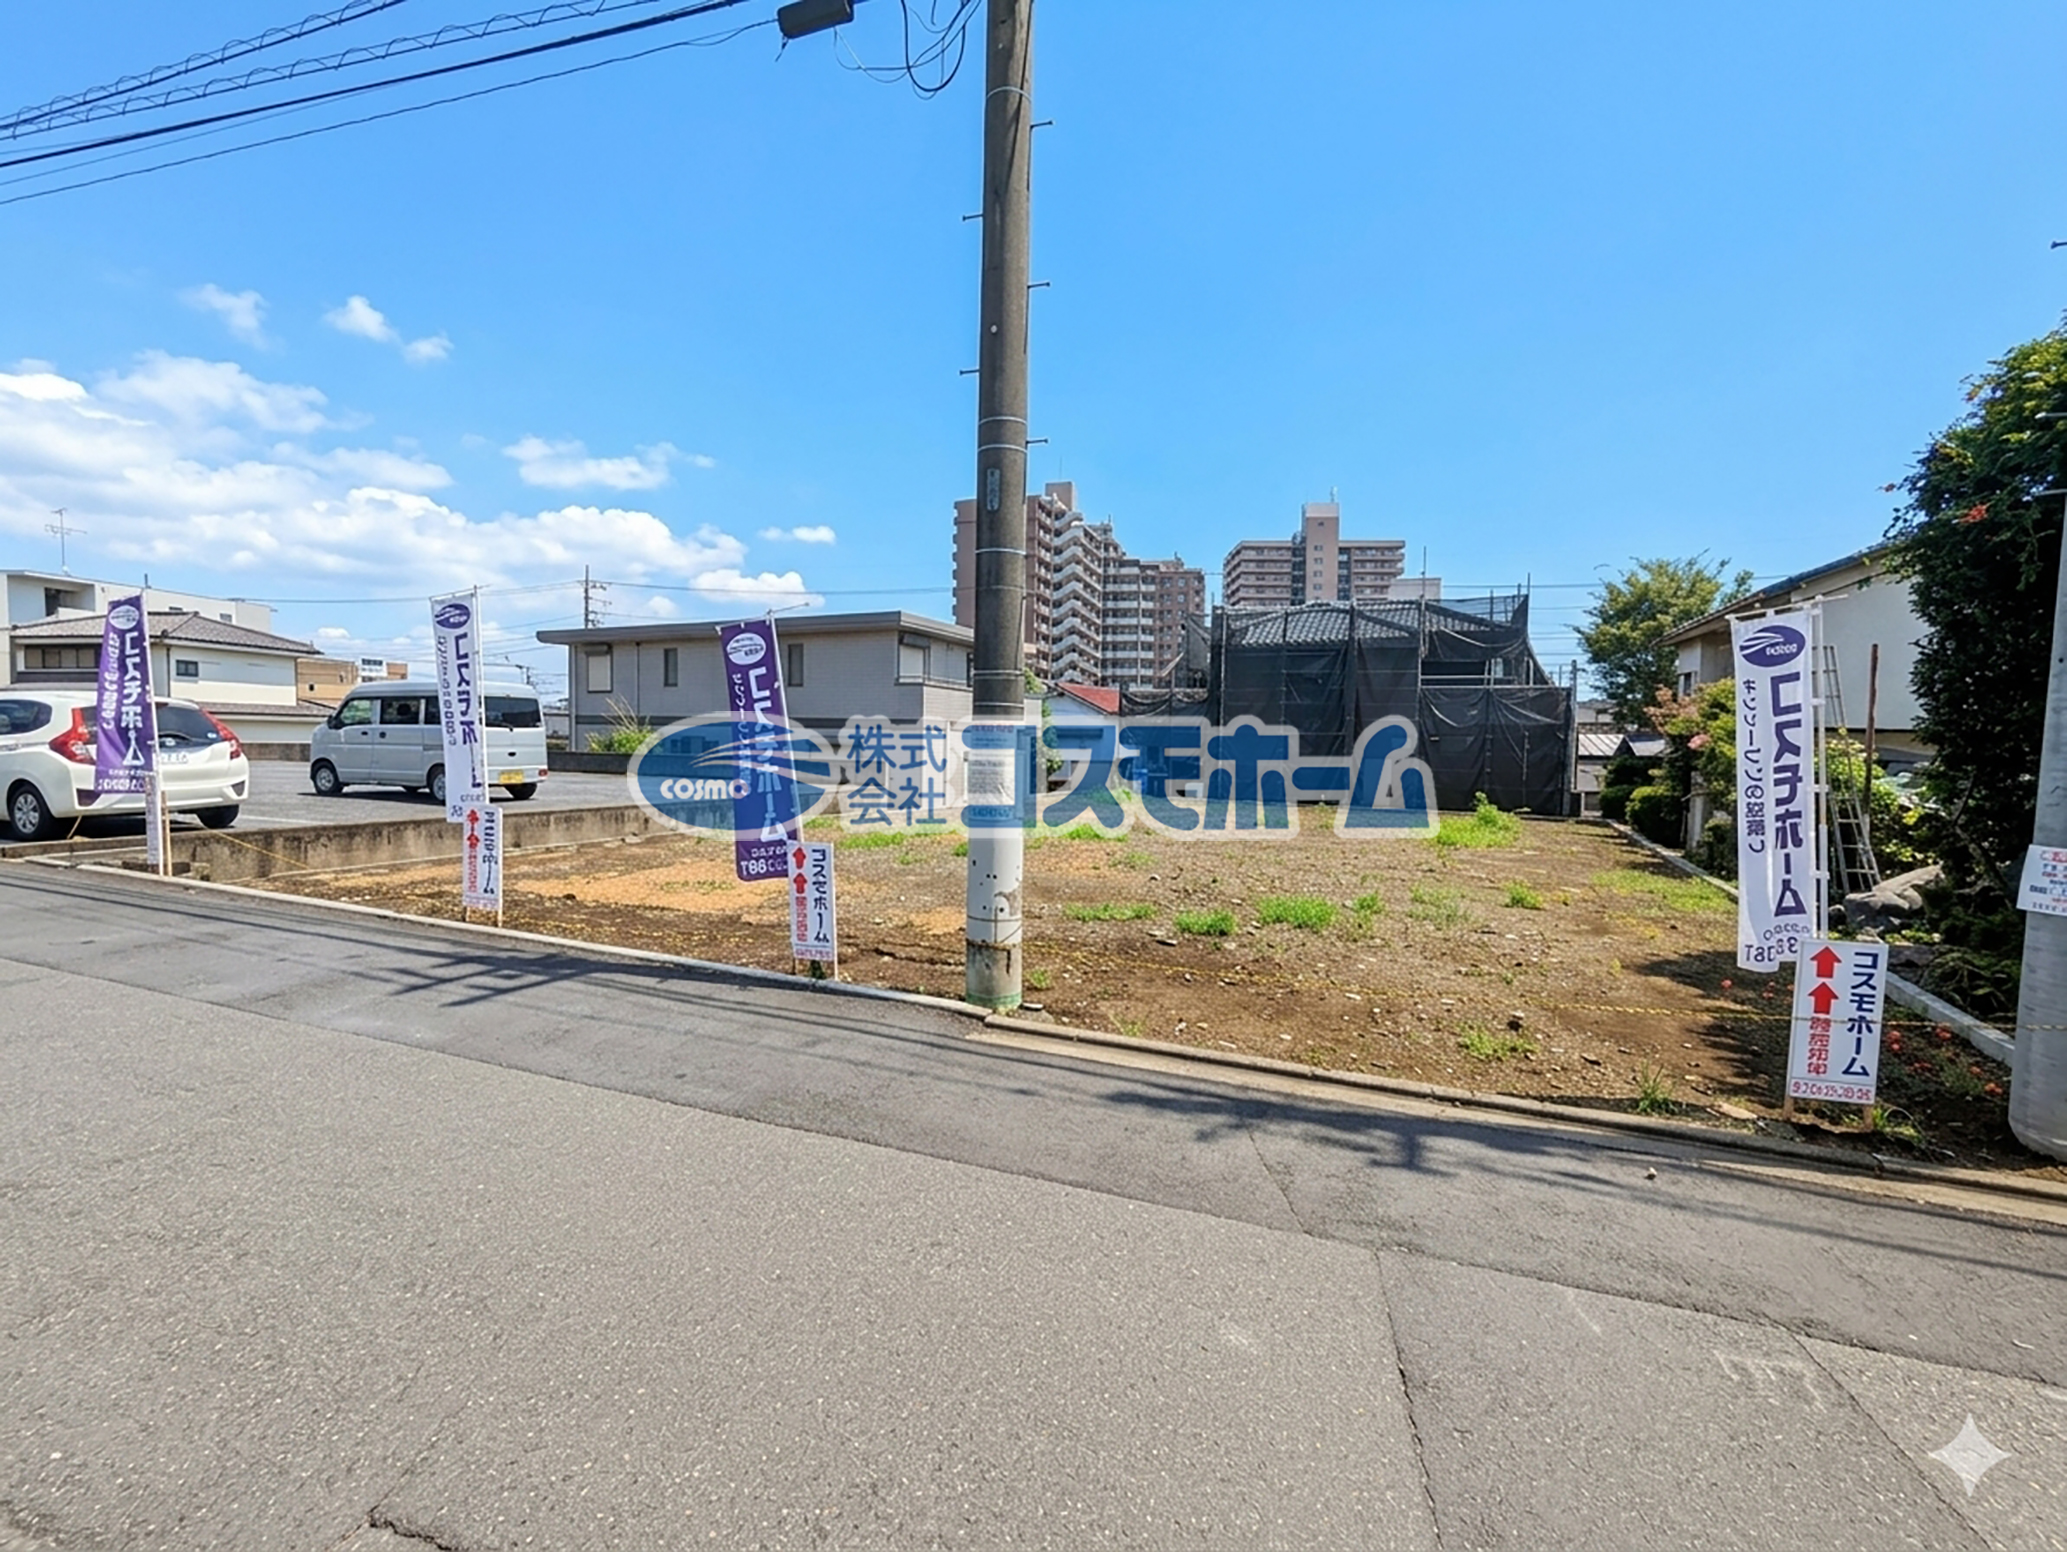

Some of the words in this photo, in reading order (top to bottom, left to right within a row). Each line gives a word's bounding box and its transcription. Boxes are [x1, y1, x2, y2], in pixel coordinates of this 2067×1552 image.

[1841, 951, 1880, 1077] コスモホーム
